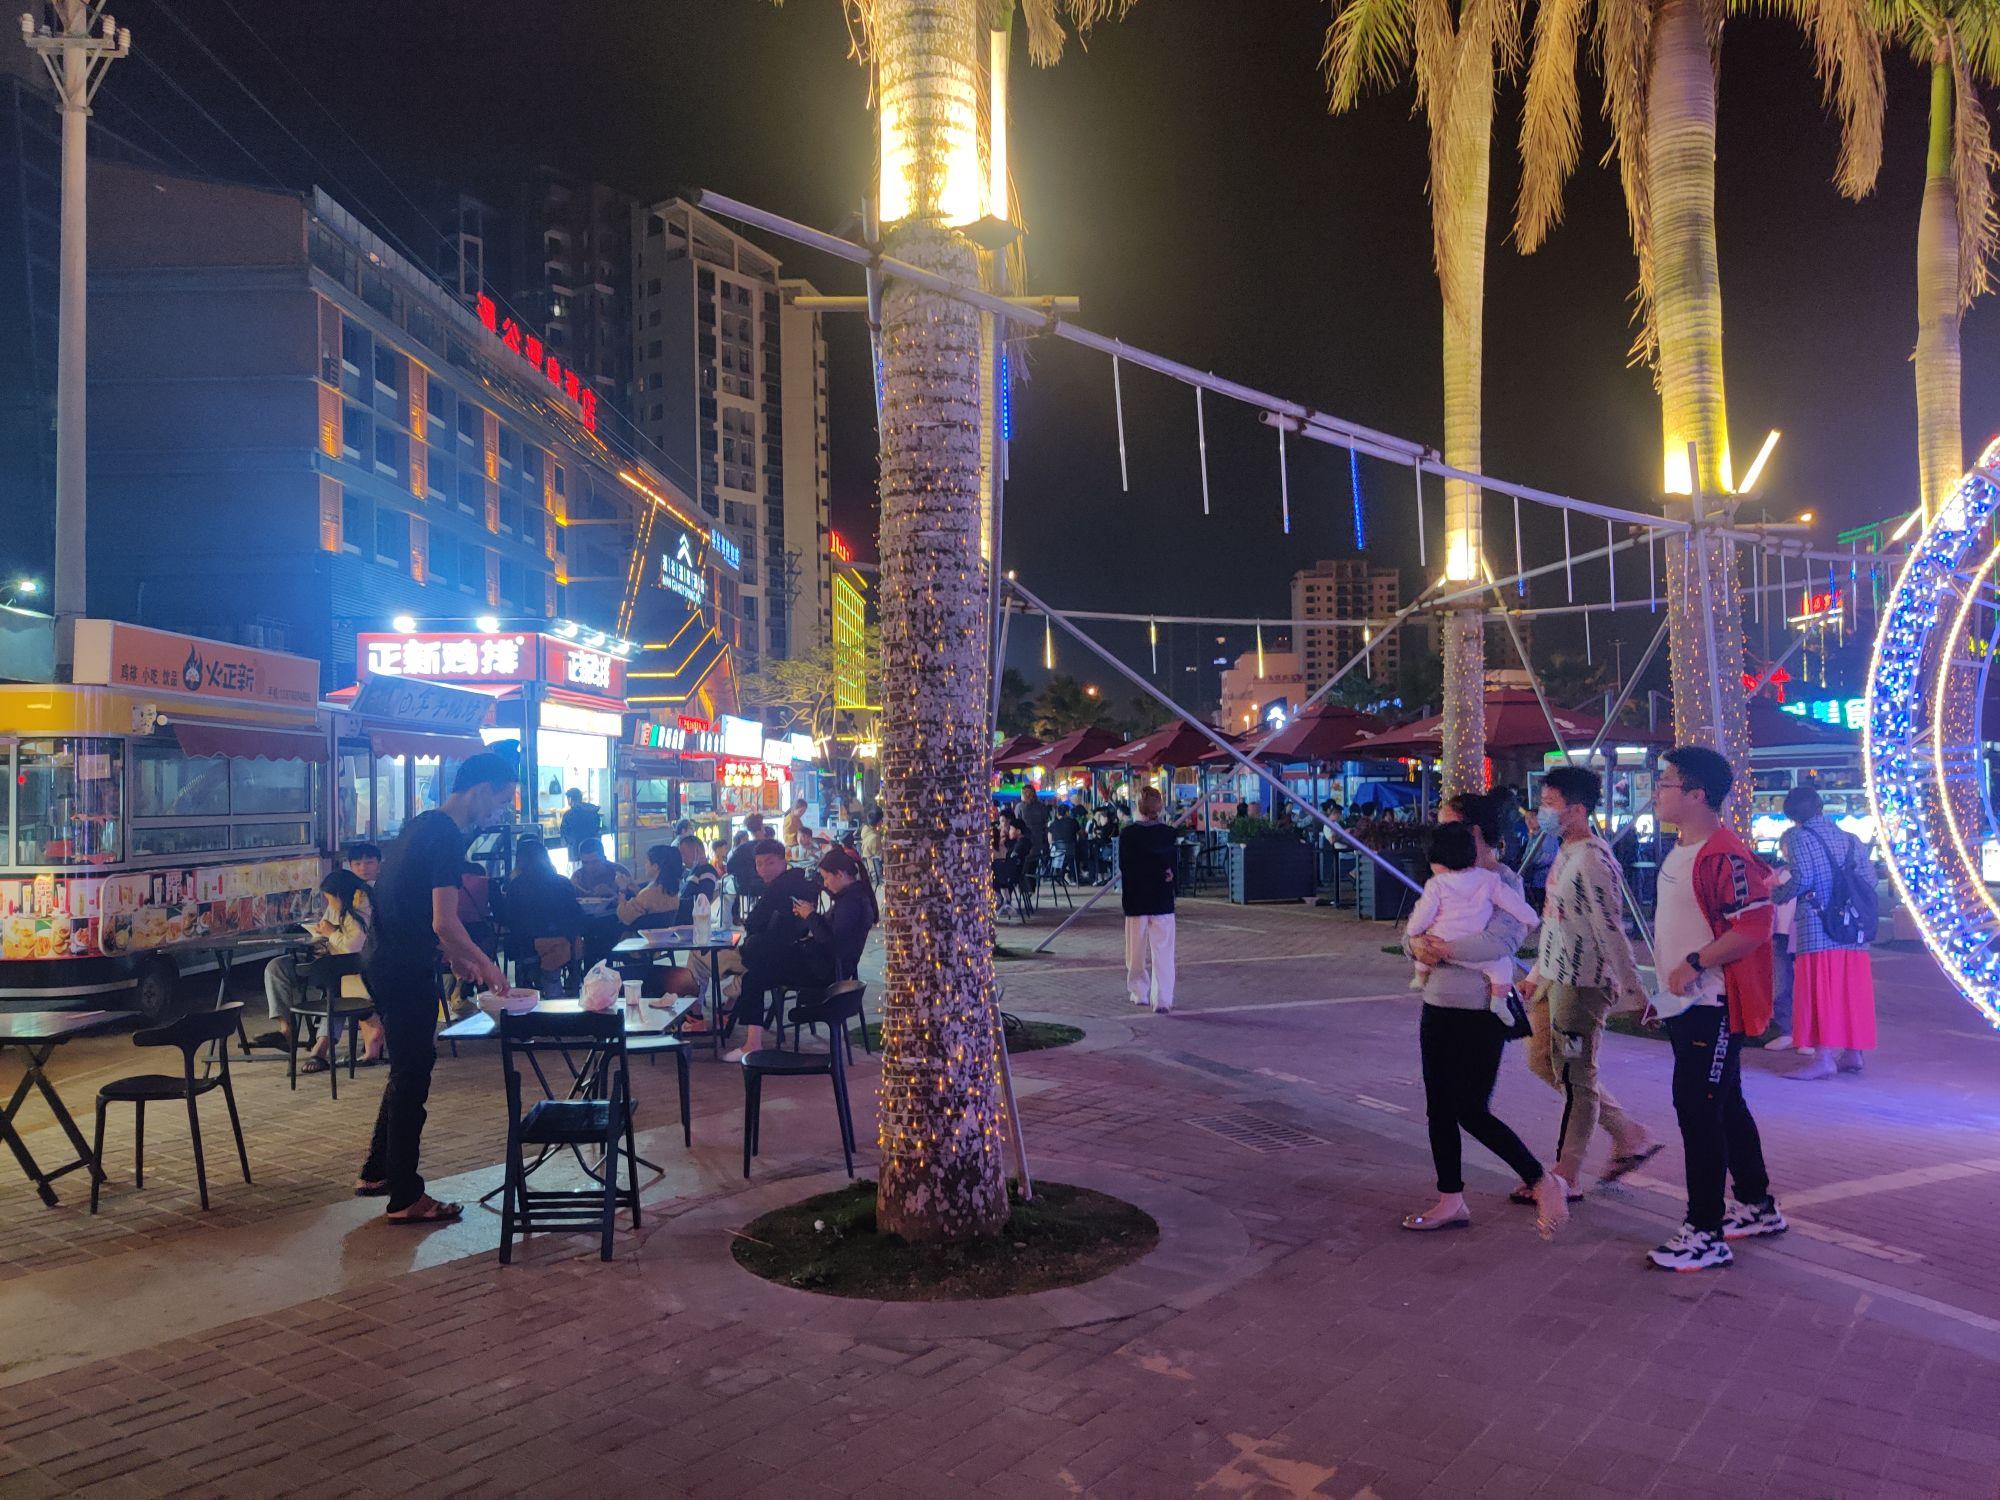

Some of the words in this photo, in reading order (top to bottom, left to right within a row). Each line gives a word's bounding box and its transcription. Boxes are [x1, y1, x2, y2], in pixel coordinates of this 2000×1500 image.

[368, 639, 519, 675] 正新鸡排
[142, 666, 158, 685] 小吃
[162, 669, 177, 687] 饮品
[206, 661, 254, 692] 火正新
